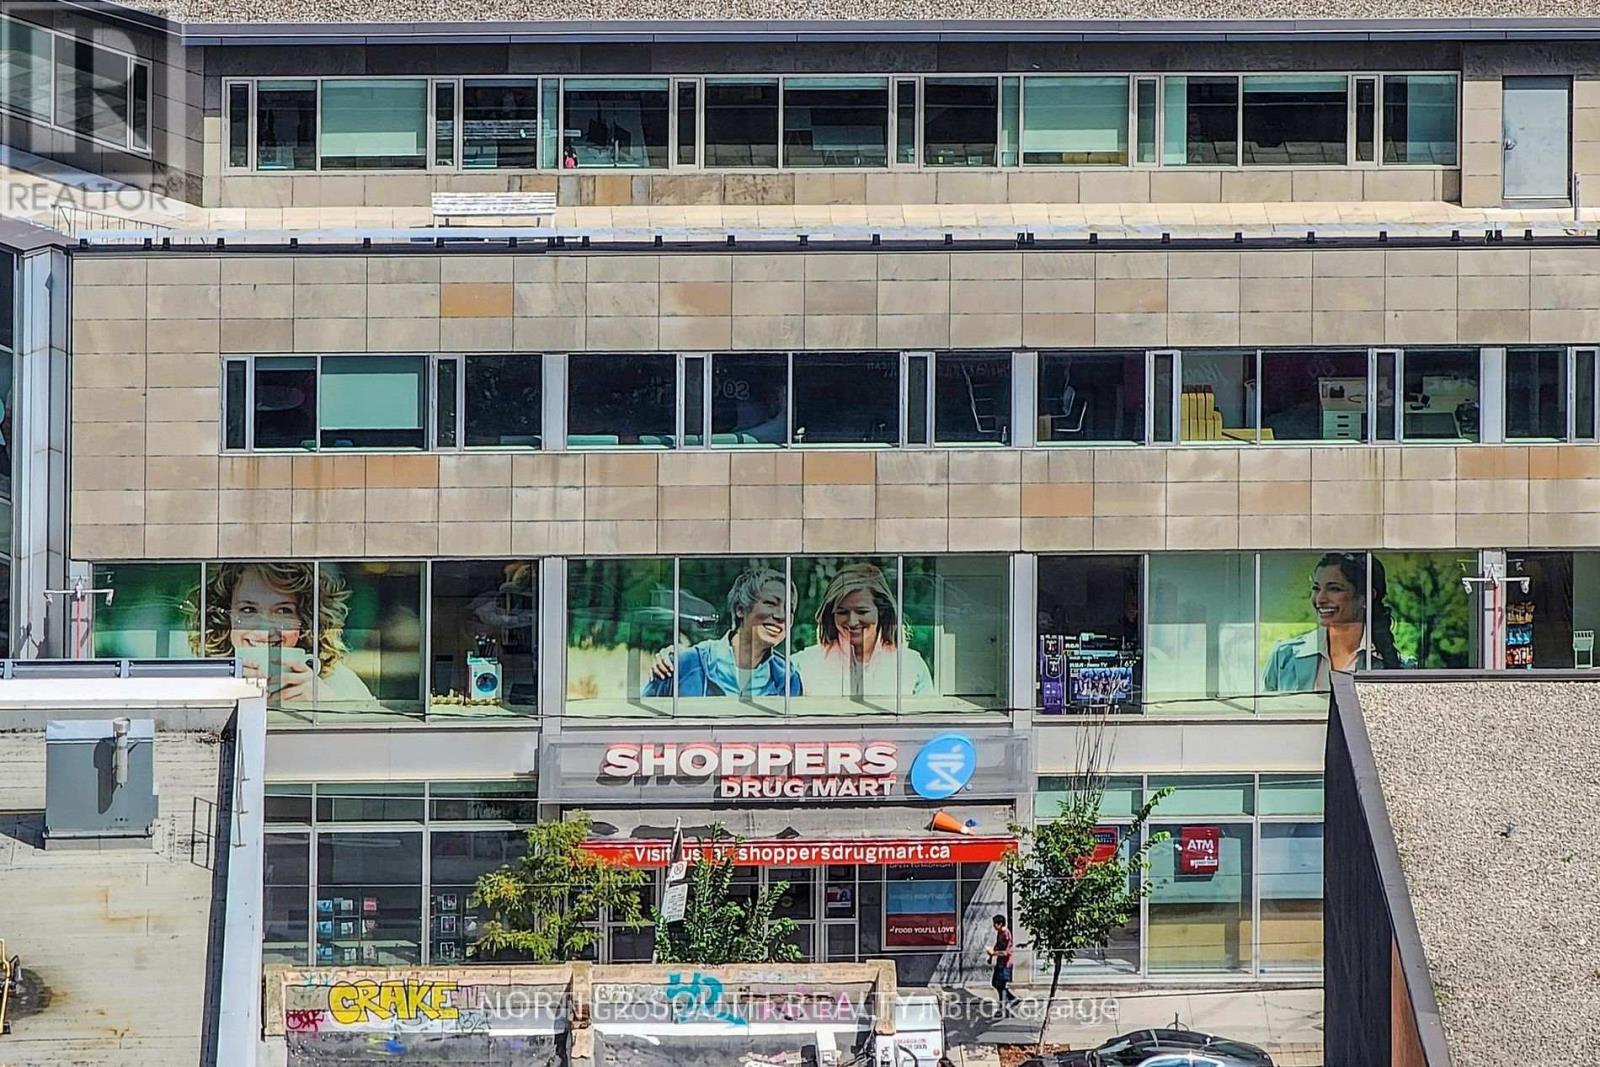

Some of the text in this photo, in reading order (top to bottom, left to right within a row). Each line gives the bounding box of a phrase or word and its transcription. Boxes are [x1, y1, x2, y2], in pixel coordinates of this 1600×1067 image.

[602, 741, 898, 777] SHOPPERS
[720, 777, 896, 798] DRUG MART
[634, 846, 672, 862] Visit
[681, 848, 702, 861] us
[738, 844, 951, 865] shoppersdrugmart.ca
[1187, 839, 1214, 850] ATM
[938, 926, 954, 934] LOVE
[328, 979, 460, 1024] CRAKE
